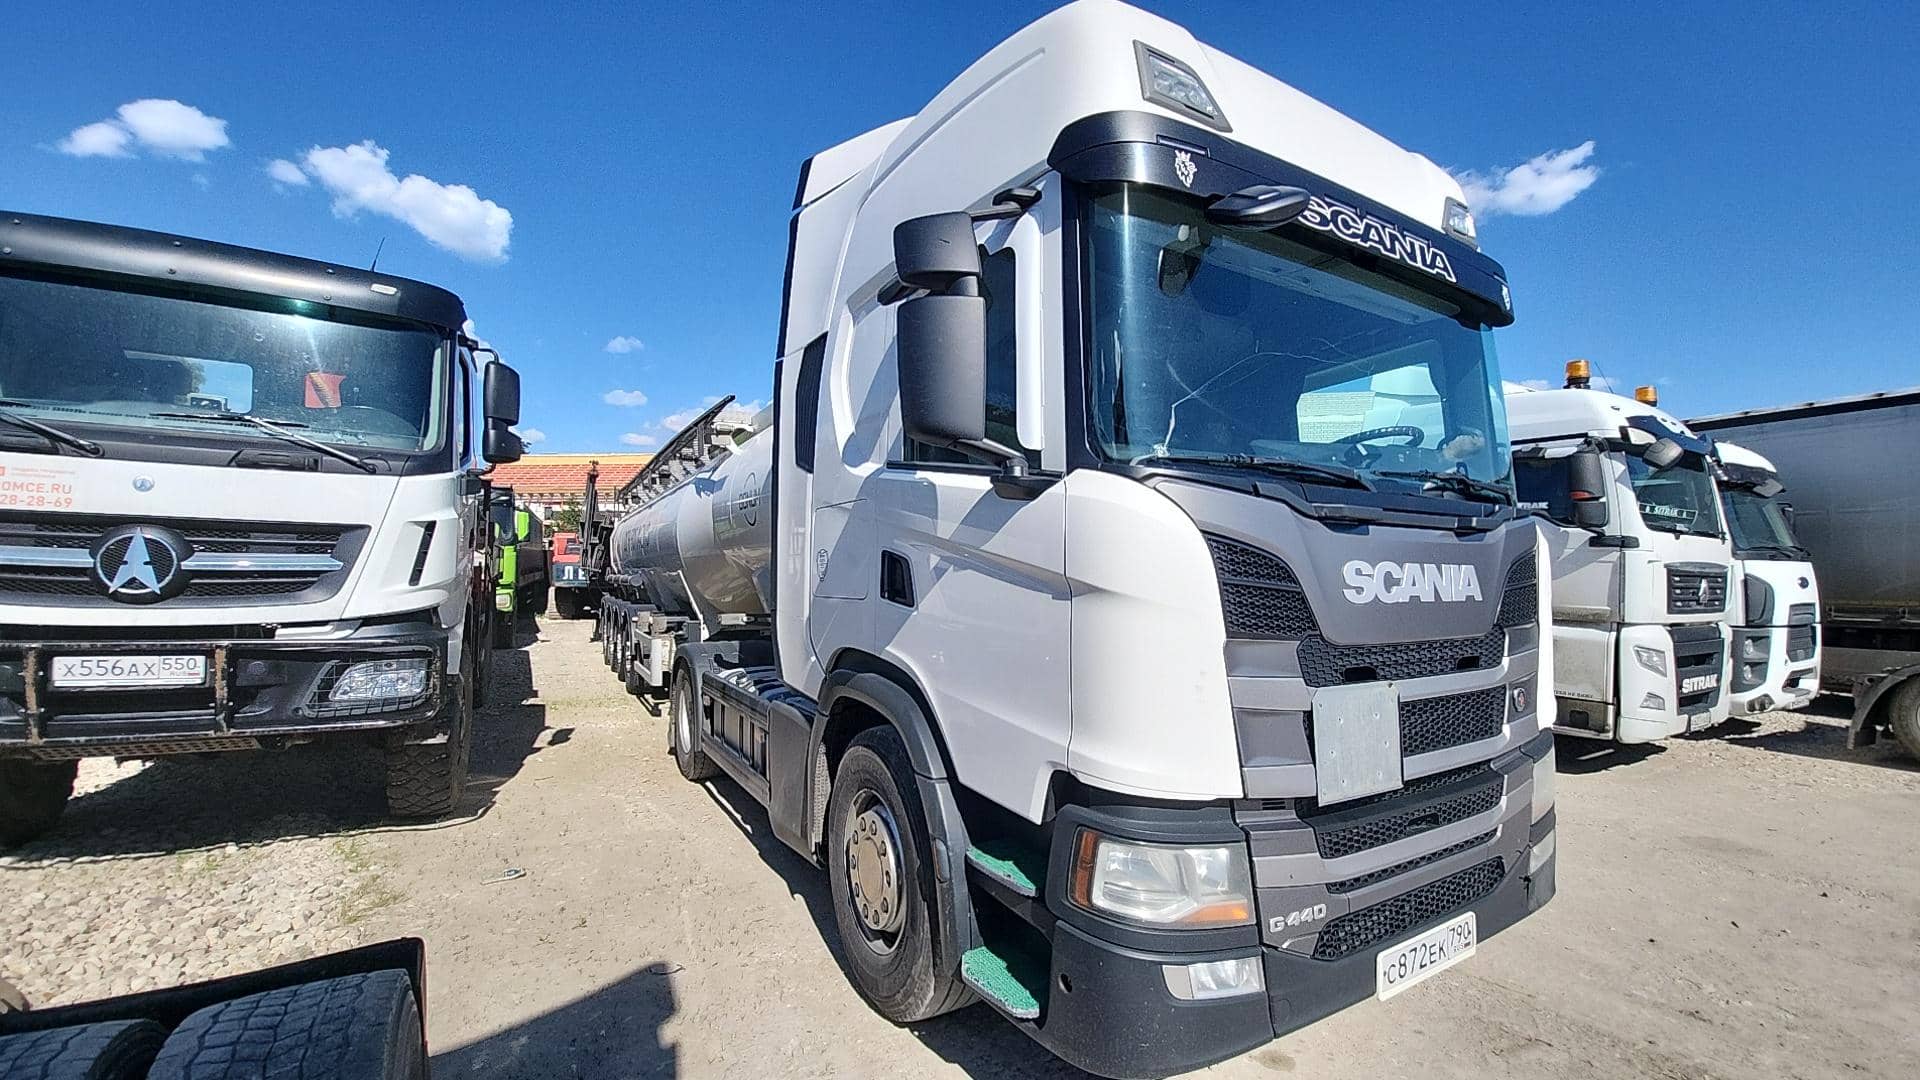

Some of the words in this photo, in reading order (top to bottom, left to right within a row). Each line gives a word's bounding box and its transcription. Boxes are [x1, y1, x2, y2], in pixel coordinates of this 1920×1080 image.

[1299, 196, 1457, 283] SCANIA
[0, 481, 72, 494] OMCE.RU
[0, 494, 73, 508] 28-28-69
[1343, 560, 1483, 604] SCANIA
[161, 657, 197, 671] 550
[1682, 674, 1718, 693] SITRAK
[1269, 903, 1327, 933] G440
[1449, 921, 1470, 947] 790
